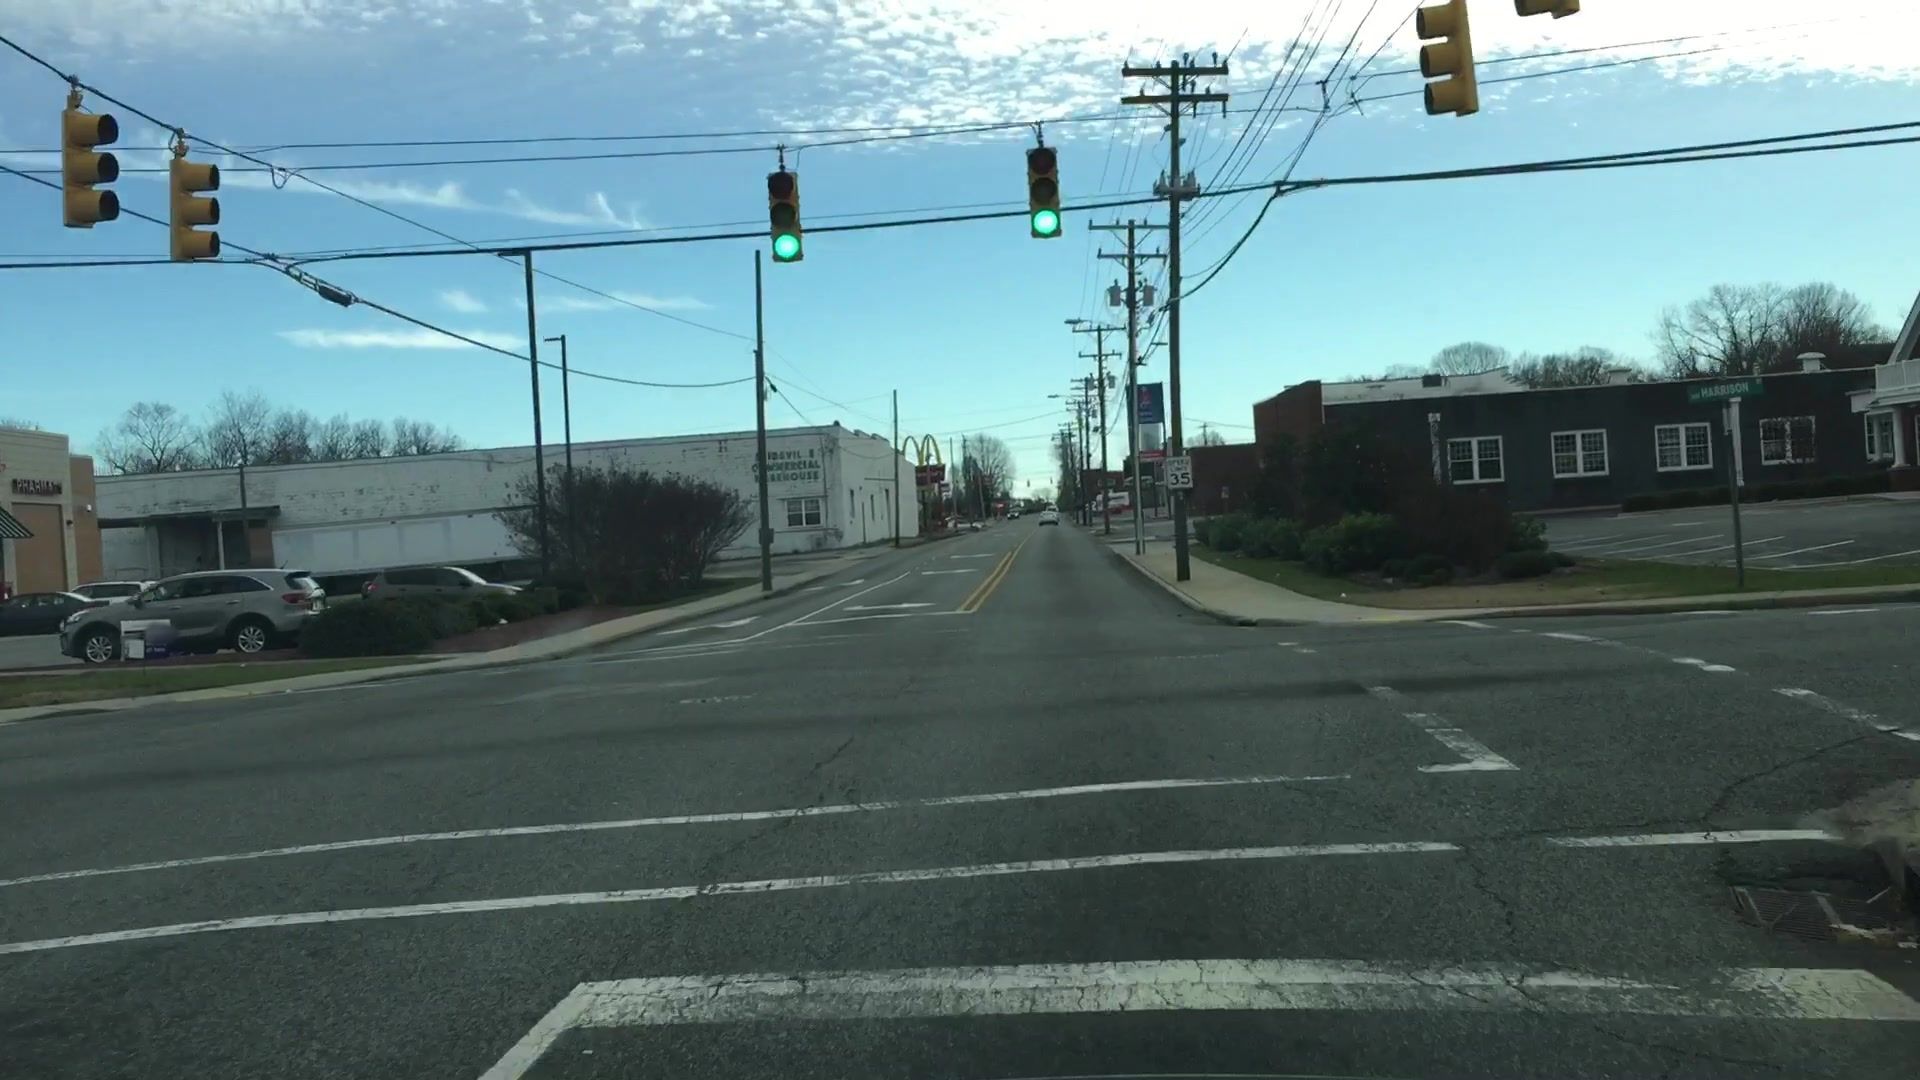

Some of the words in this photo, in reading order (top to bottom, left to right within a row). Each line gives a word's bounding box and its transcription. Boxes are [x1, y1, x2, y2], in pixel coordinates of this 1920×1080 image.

[1701, 382, 1749, 397] HARRISON
[752, 460, 820, 472] CMMERCIAL
[1171, 472, 1190, 485] 35
